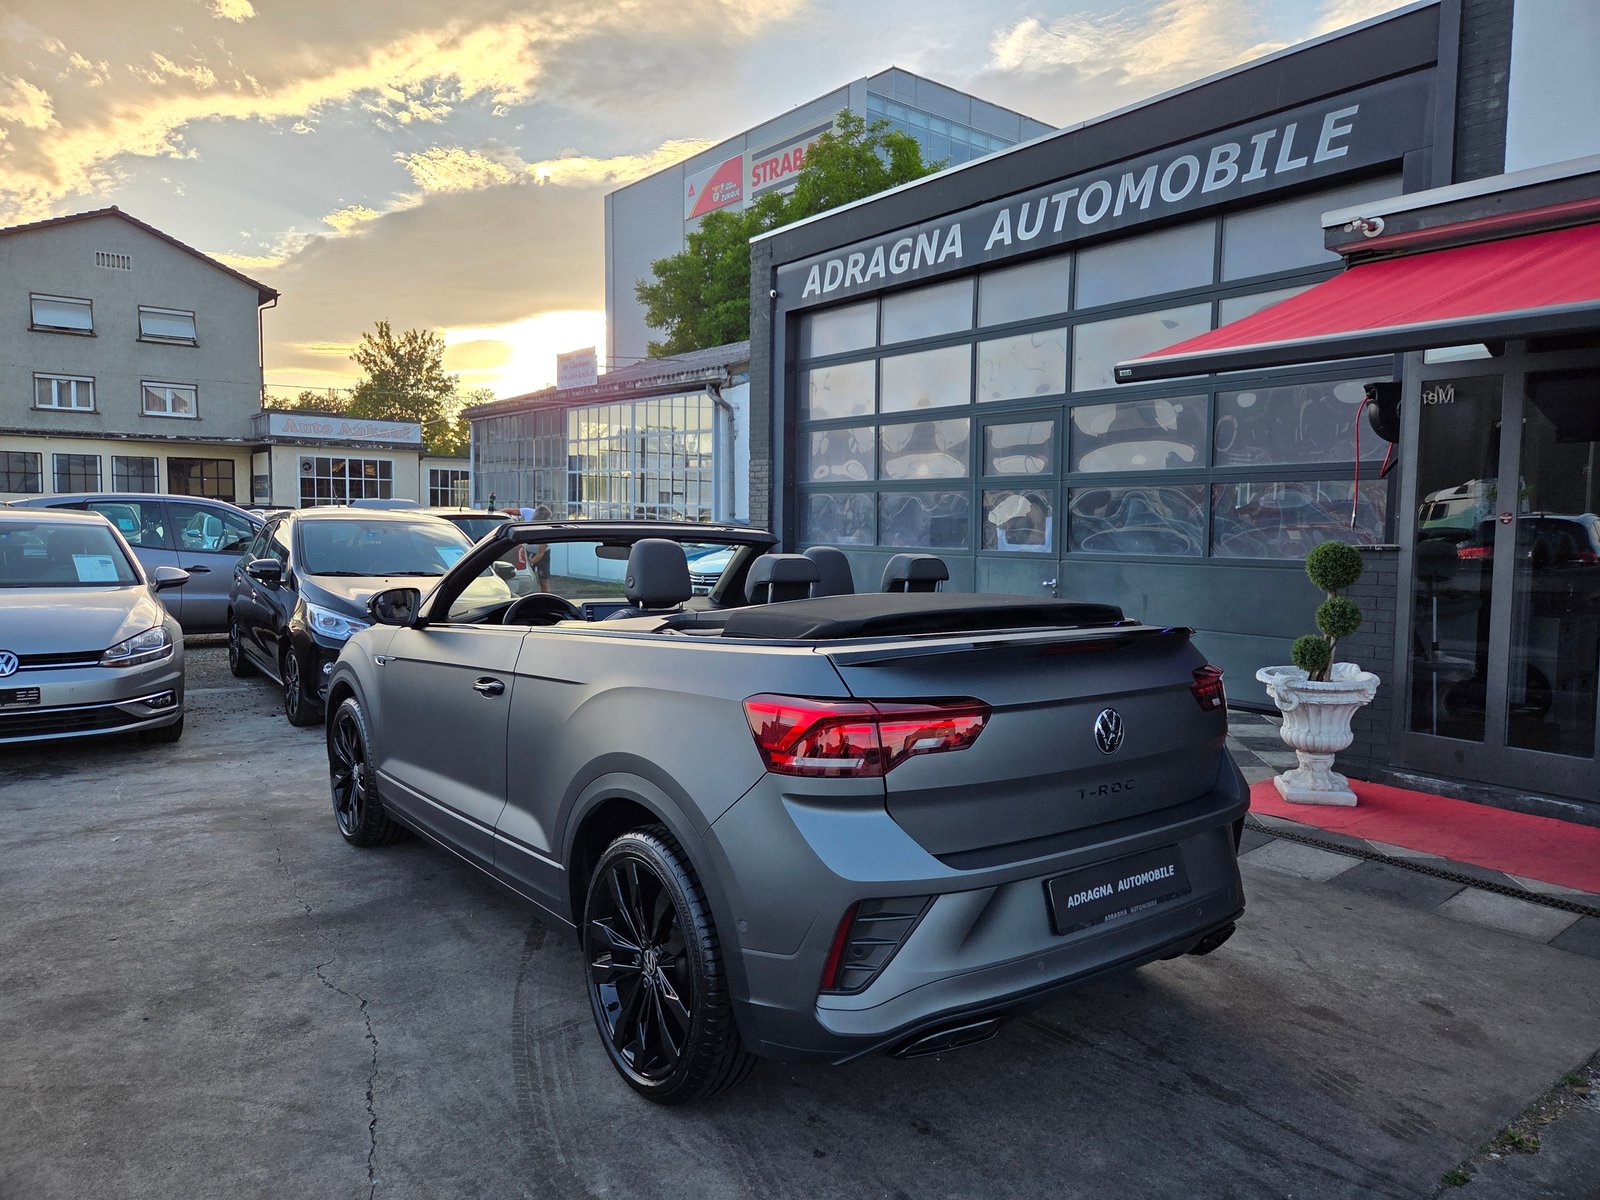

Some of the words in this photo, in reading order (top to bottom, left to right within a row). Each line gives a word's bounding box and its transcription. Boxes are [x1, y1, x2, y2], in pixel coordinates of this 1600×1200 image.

[751, 143, 812, 187] STRAB
[801, 223, 963, 299] ADRAGNA
[984, 104, 1360, 250] AUTOMOBILE
[282, 418, 332, 435] Auto
[1077, 779, 1135, 800] T-ROC
[1067, 883, 1114, 908] ADRAGNA
[1117, 864, 1175, 892] AUTOMOBILE
